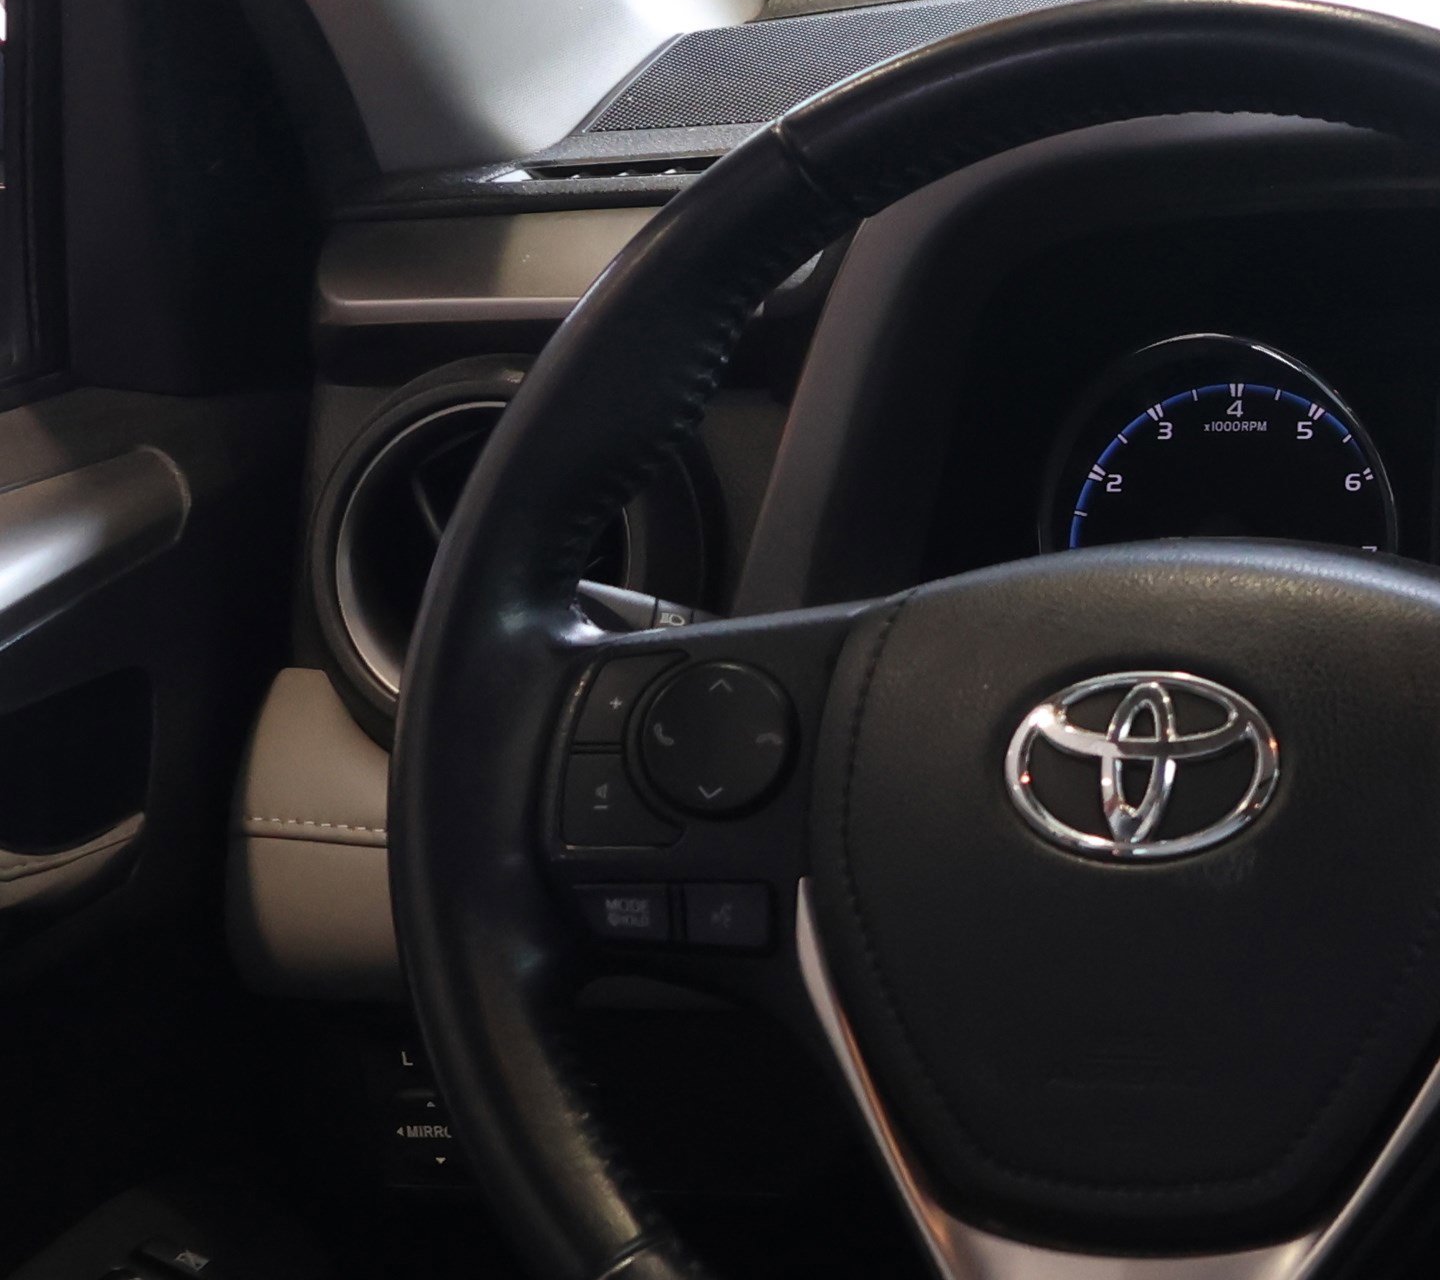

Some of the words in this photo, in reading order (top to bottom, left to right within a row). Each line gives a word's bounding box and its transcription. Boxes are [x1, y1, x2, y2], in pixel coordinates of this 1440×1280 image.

[1226, 400, 1244, 418] 4
[1157, 423, 1172, 440] 3
[1297, 422, 1313, 440] 5
[1106, 475, 1123, 493] 2
[1345, 473, 1361, 491] 6
[402, 1051, 413, 1066] L
[407, 1126, 452, 1138] MIRR
